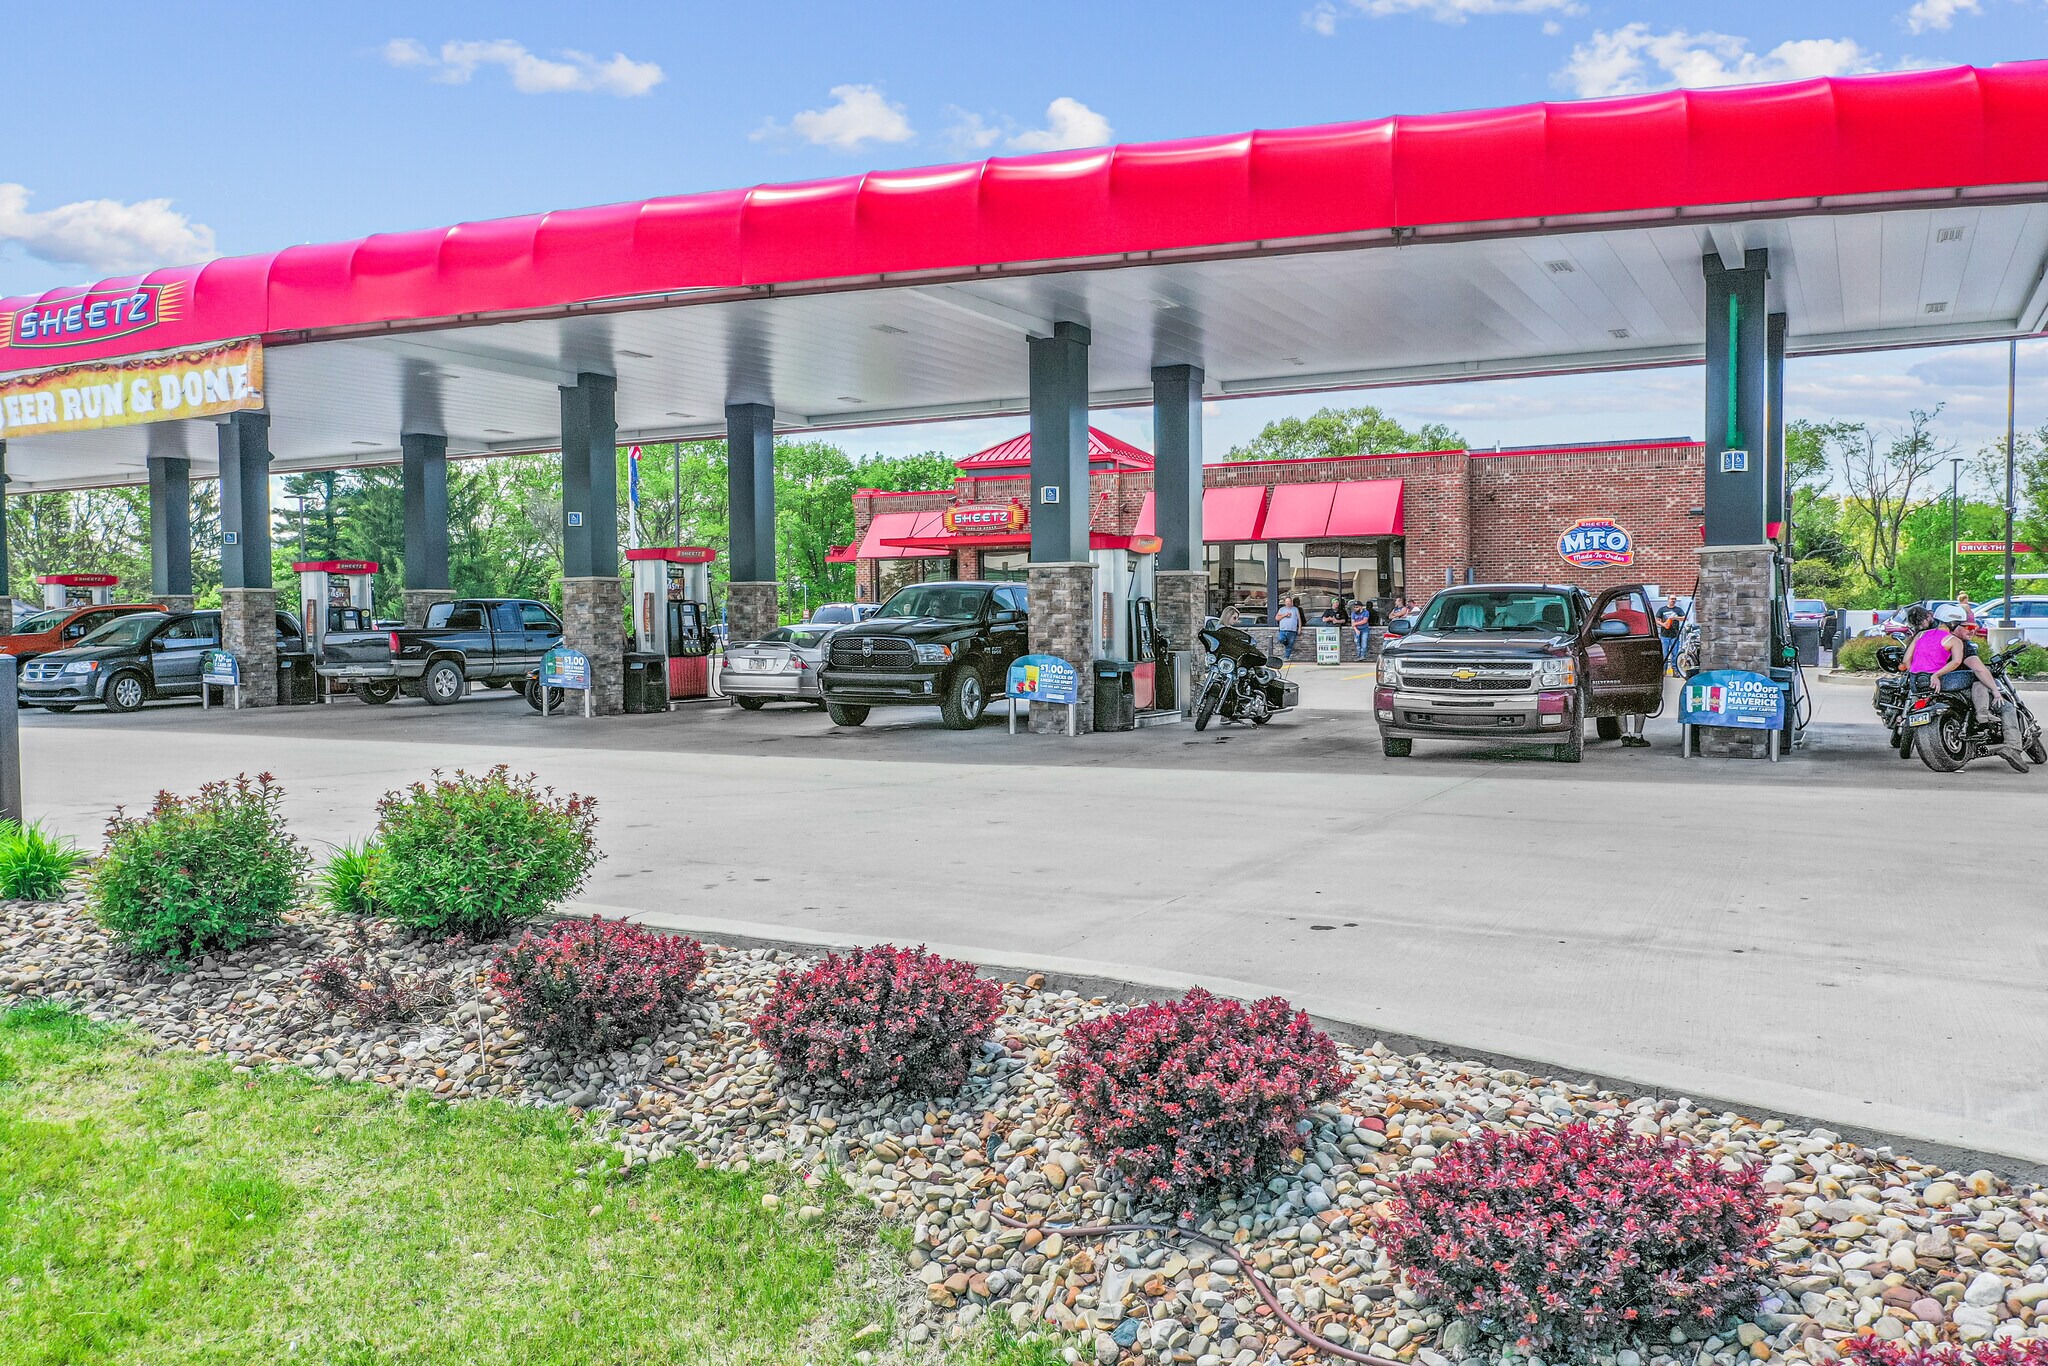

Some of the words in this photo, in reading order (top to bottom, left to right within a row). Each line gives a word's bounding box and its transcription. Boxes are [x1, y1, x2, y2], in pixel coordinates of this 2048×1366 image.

[20, 293, 149, 339] SHEETZ
[0, 391, 57, 430] EER
[61, 382, 124, 421] RUN
[131, 378, 155, 412] &
[954, 511, 1008, 524] SHEETZ
[564, 656, 585, 666] $1.00
[1040, 664, 1064, 675] $1.00
[1728, 681, 1763, 693] $1.00
[1727, 697, 1777, 707] MAVERICK
